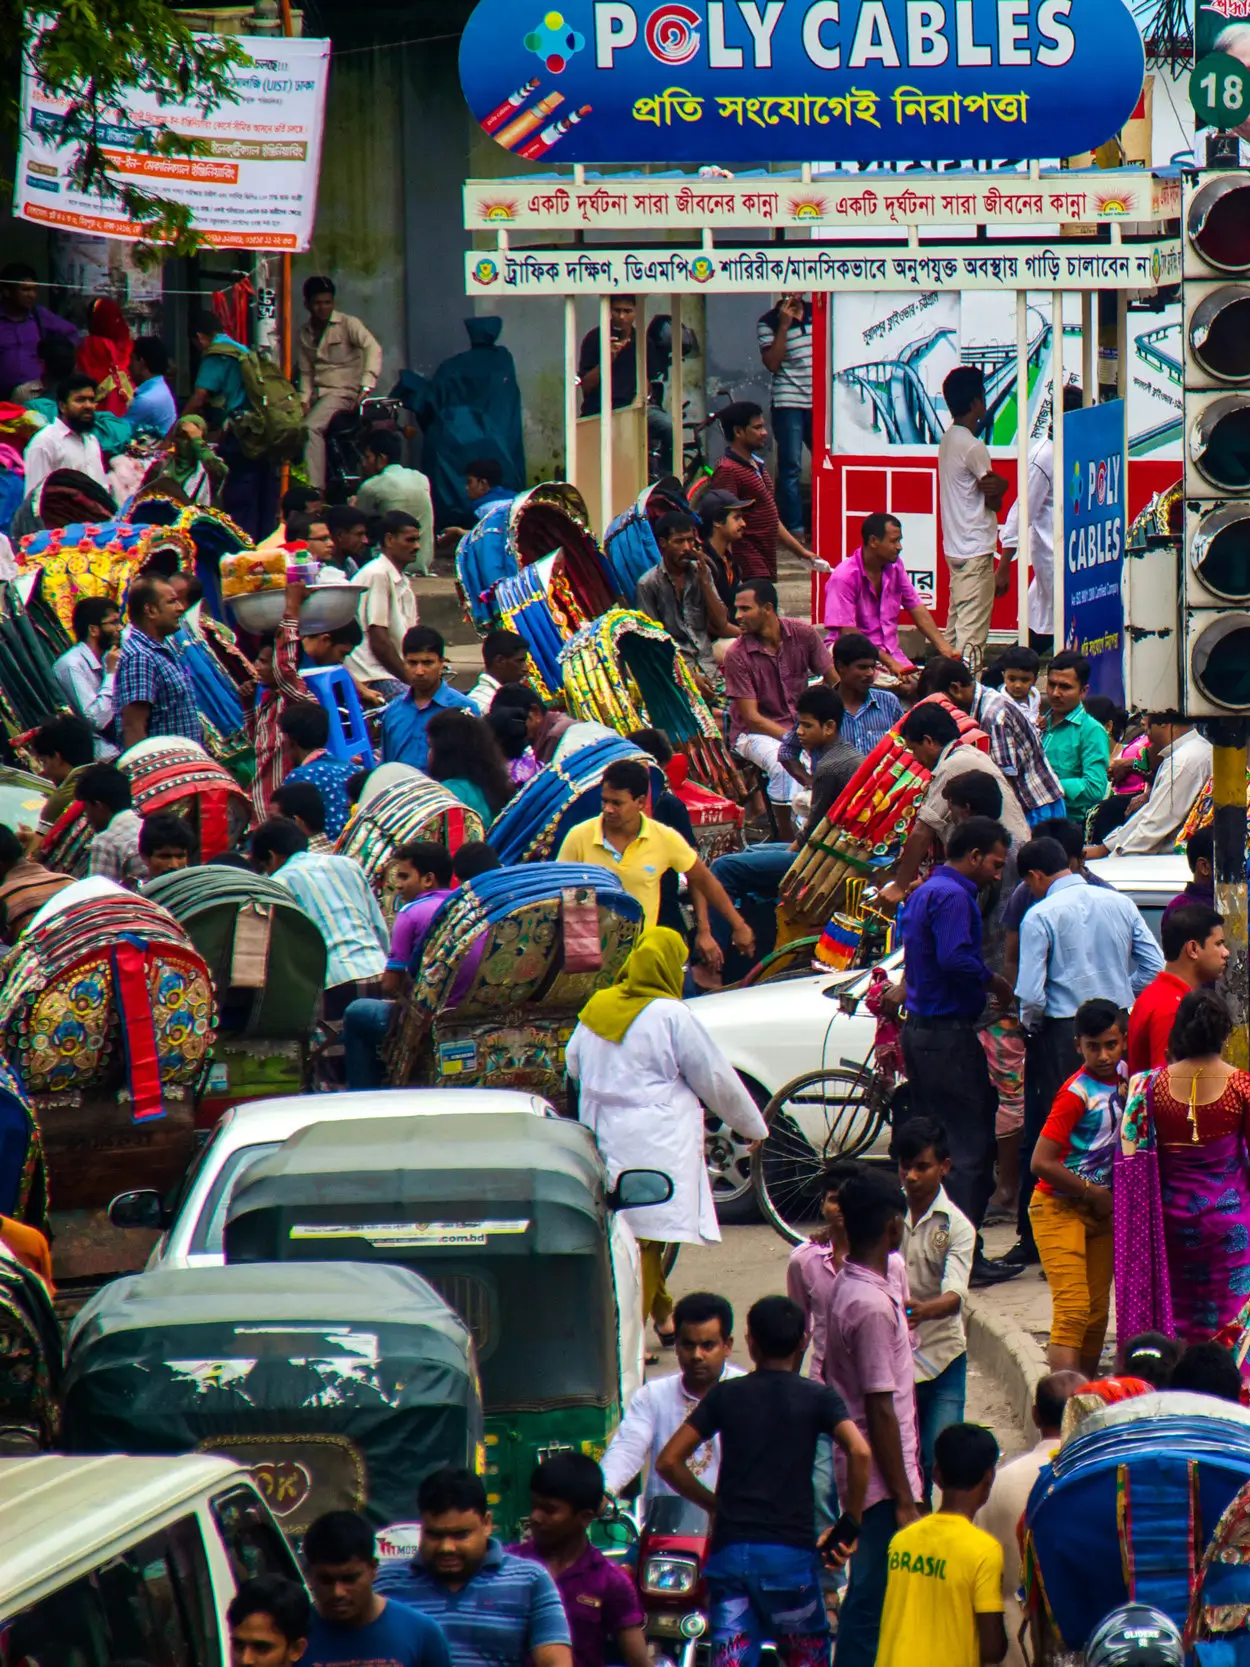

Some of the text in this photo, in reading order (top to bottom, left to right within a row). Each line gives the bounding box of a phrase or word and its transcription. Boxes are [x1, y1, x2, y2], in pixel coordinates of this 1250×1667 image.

[593, 0, 1077, 71] POLY CABLES
[631, 85, 1031, 128] প্রতি সংযোগেই নিরাপত্তা
[1200, 71, 1243, 110] 18
[527, 187, 779, 222] একটি দূর্ঘটনা সারা জীবনের কান্না
[835, 187, 1087, 223] একটি দূর্ঘটনা সারা জীবনের কান্না
[504, 254, 689, 287] ট্রাফিক দক্ষিণ, ডিএমপি
[719, 251, 886, 285] শারিরীক/মানসিকভাবে
[893, 256, 957, 285] অনুপযুক্ত
[963, 254, 1018, 285] অবস্থায়
[1024, 248, 1061, 283] গাড়ি
[1065, 253, 1130, 278] চালাবেন
[1087, 455, 1121, 513] POLY
[1068, 517, 1121, 574] CABLES
[890, 1551, 947, 1580] BRASIL
